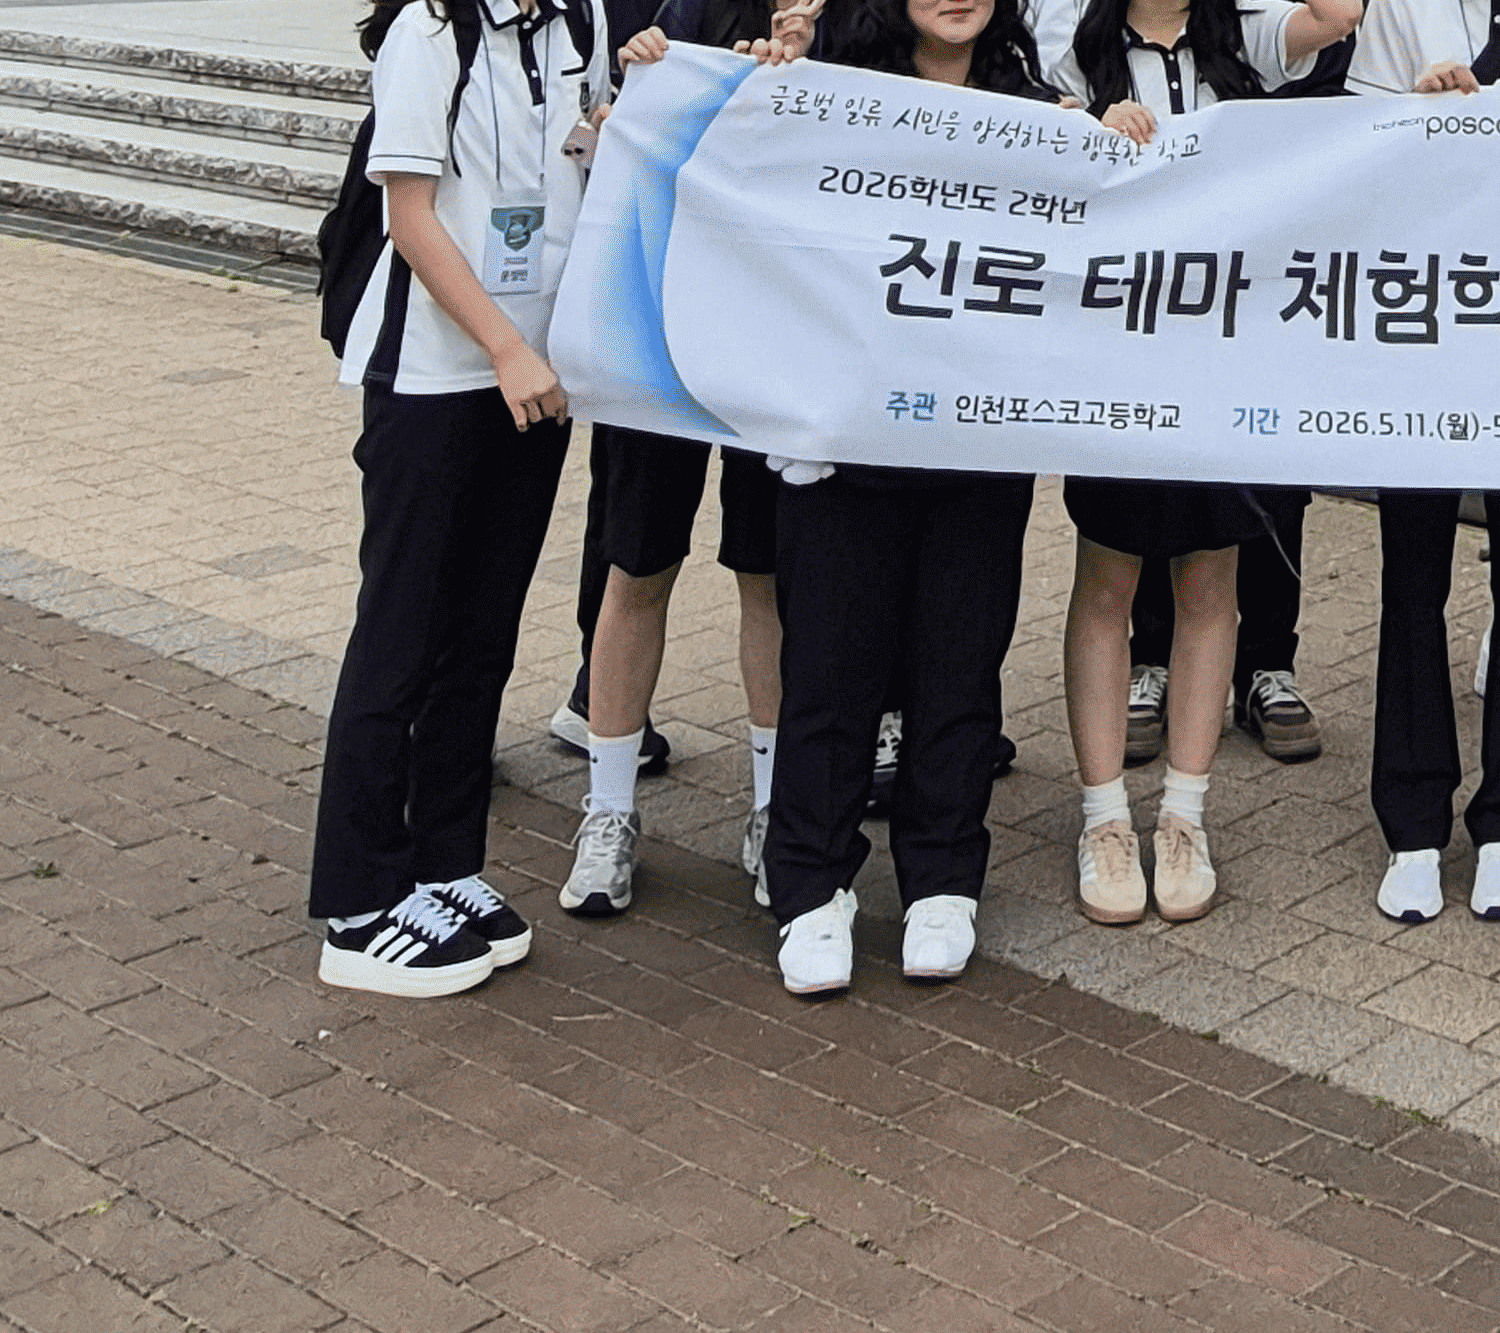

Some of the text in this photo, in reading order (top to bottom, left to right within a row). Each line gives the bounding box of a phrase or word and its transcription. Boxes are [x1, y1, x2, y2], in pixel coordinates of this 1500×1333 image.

[770, 85, 835, 121] 글로벌
[845, 97, 882, 126] 일류
[892, 106, 960, 141] 시민을
[973, 116, 1069, 154] 양성하는
[818, 165, 1088, 225] 2026학년도 2학년
[879, 233, 1046, 320] 진로
[1080, 250, 1252, 338] 테마
[885, 390, 938, 422] 주관
[955, 395, 1181, 432] 인천포스코고등학교
[1232, 406, 1281, 436] 기간
